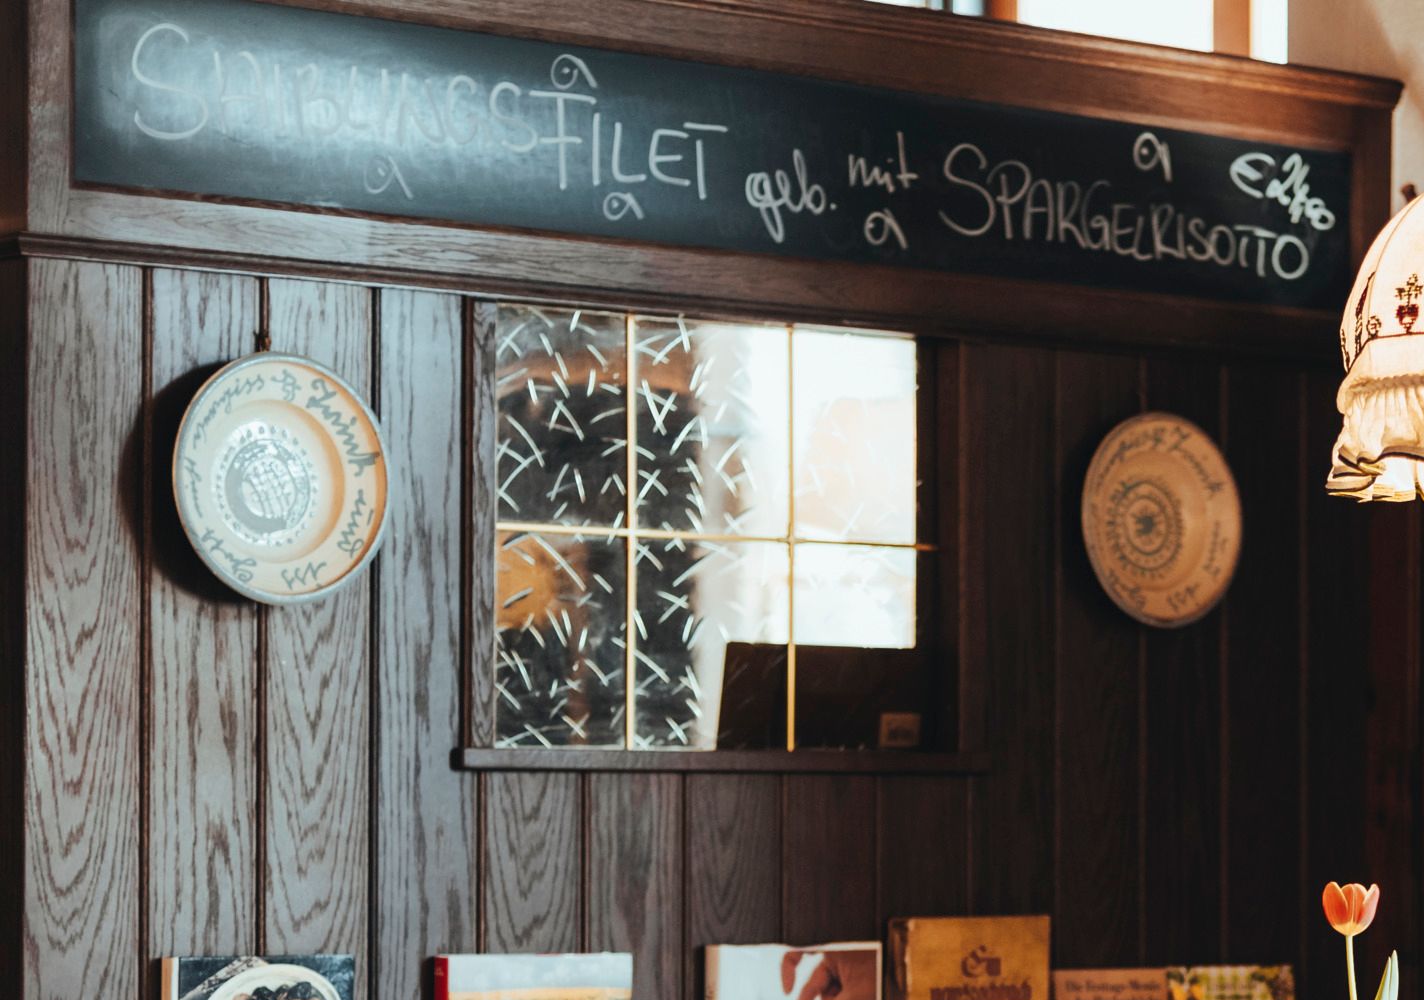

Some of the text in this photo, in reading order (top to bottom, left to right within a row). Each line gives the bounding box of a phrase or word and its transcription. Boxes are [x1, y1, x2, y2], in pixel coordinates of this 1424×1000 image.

[744, 148, 838, 244] geb.
[848, 131, 919, 194] mit
[938, 143, 1310, 280] SPARGELRISOTTO
